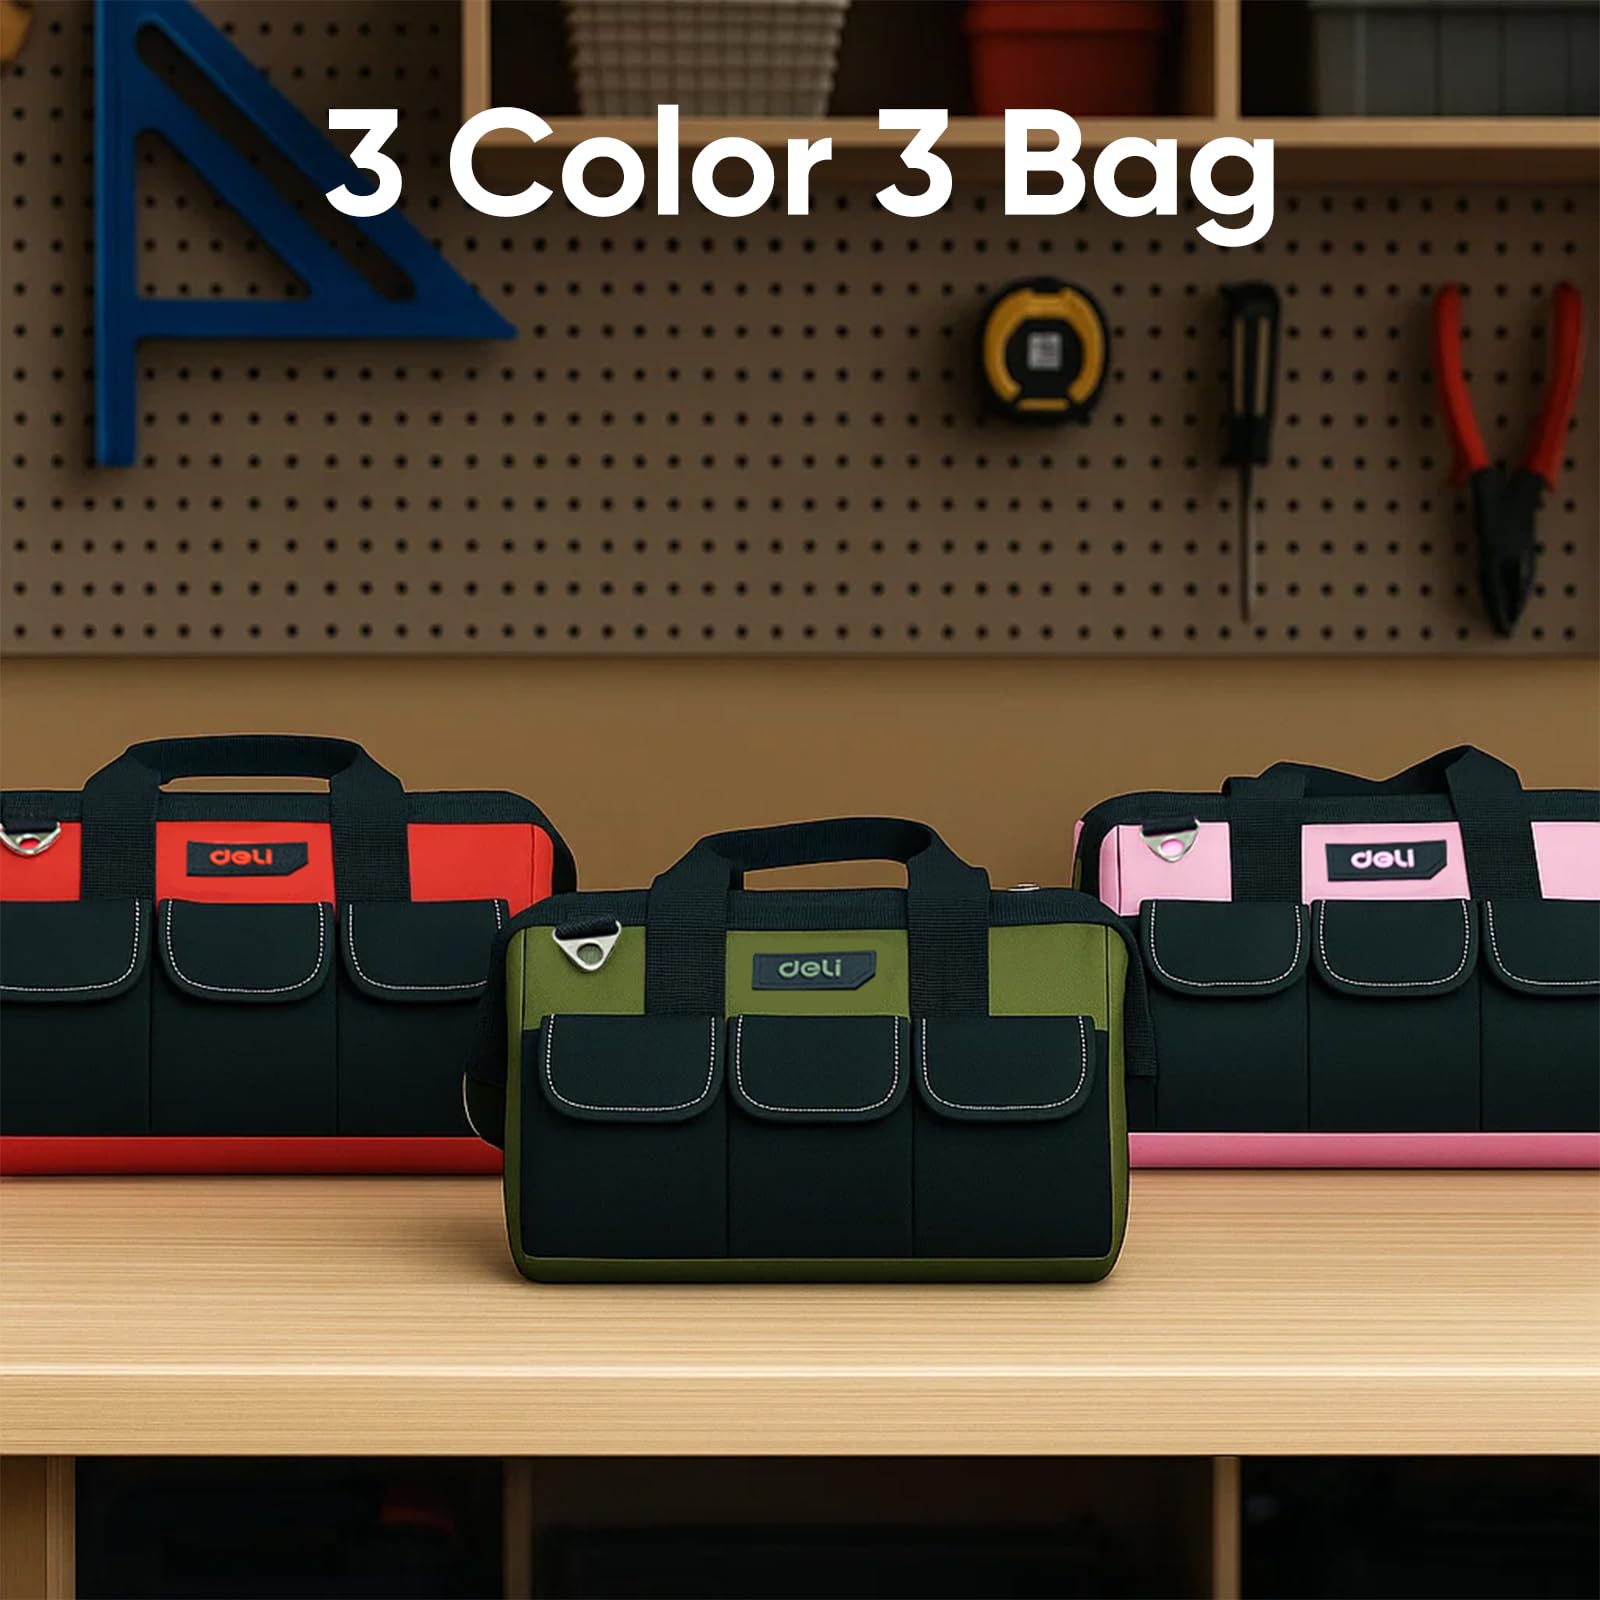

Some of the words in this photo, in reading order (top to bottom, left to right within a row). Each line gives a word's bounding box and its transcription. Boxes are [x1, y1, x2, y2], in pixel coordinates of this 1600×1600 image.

[209, 848, 273, 866] deli
[1350, 848, 1415, 869] deli
[778, 959, 842, 978] deli
